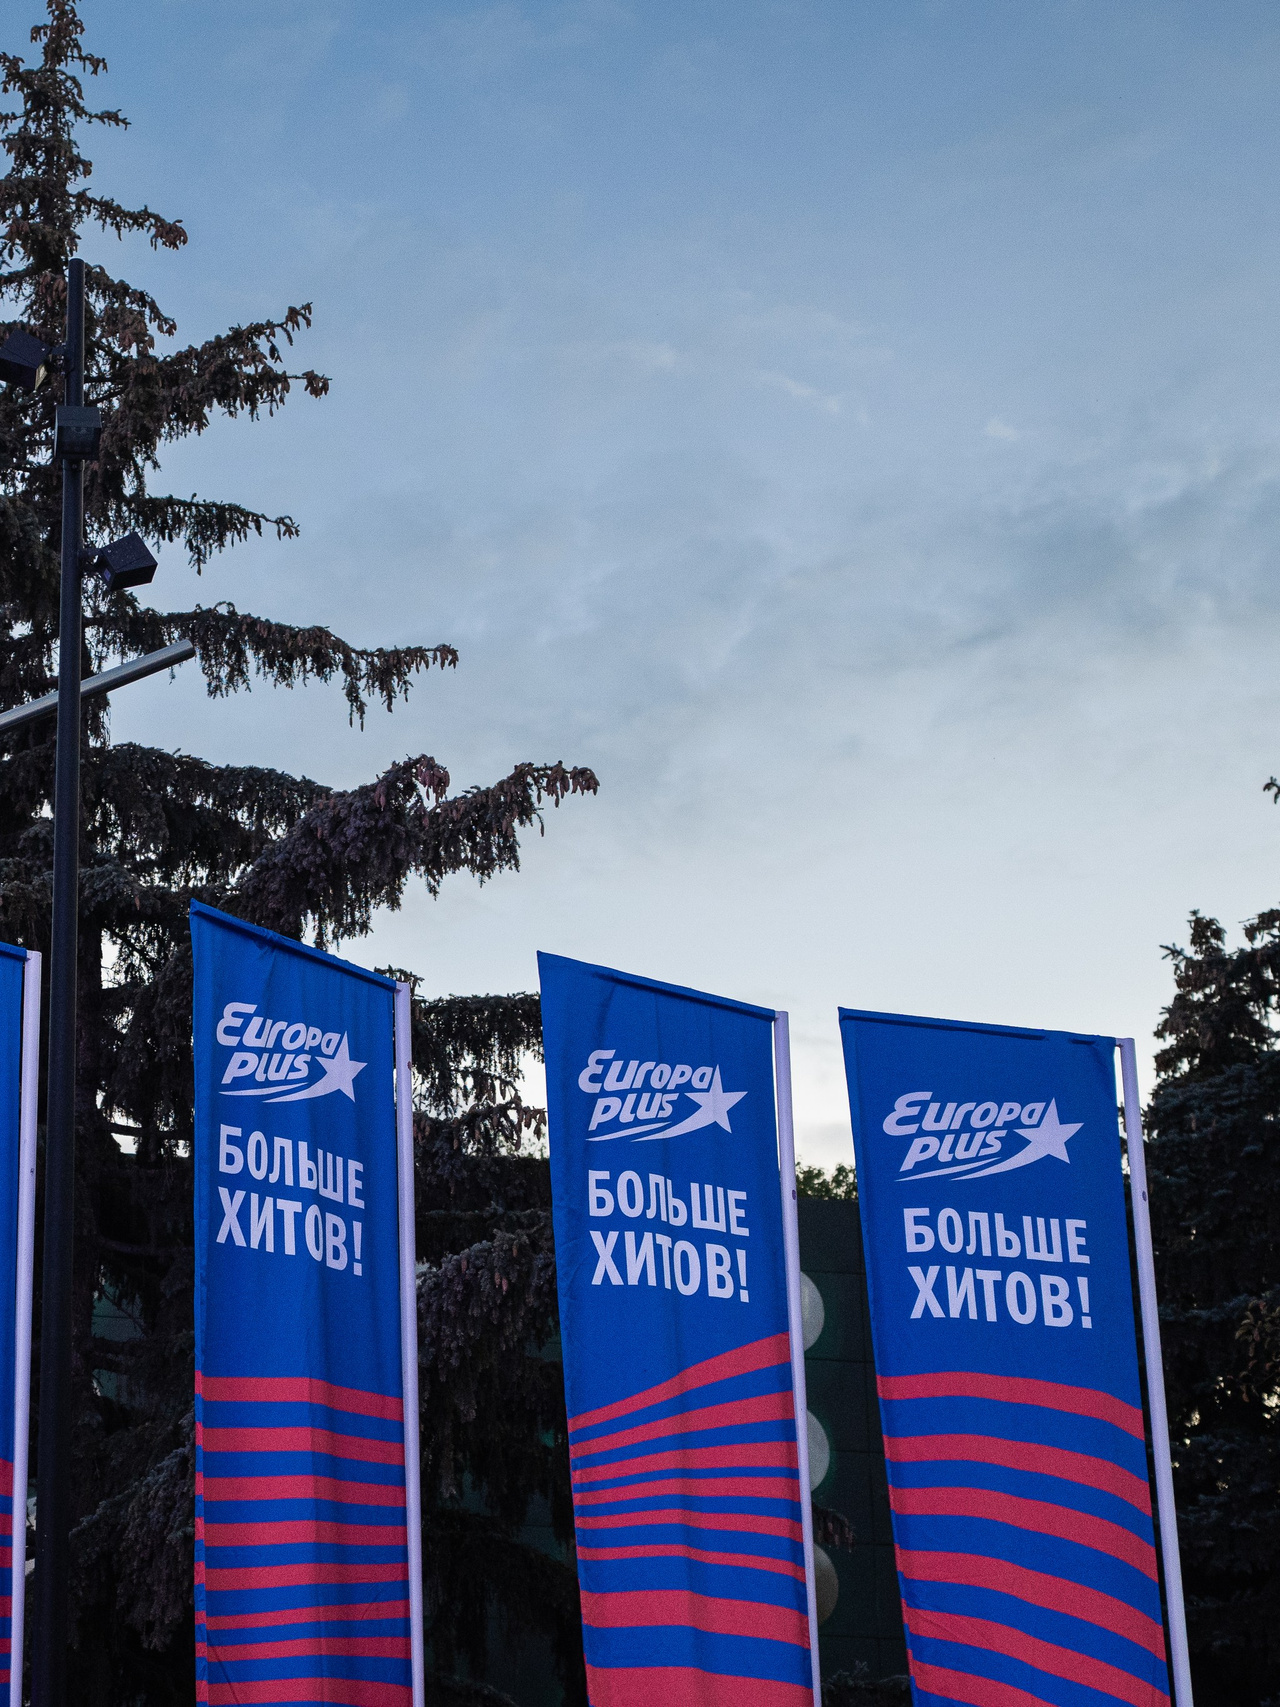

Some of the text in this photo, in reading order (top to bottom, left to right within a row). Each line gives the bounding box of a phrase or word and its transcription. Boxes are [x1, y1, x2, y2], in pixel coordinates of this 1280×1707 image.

[219, 1123, 365, 1209] БОЛЬШЕ
[216, 1186, 362, 1276] ХИТОВ!
[588, 1169, 750, 1237] БОЛЬШЕ
[903, 1207, 1091, 1264] БОЛЬШЕ
[589, 1230, 750, 1303] ХИТОВ!
[907, 1265, 1093, 1329] ХИТОВ!
